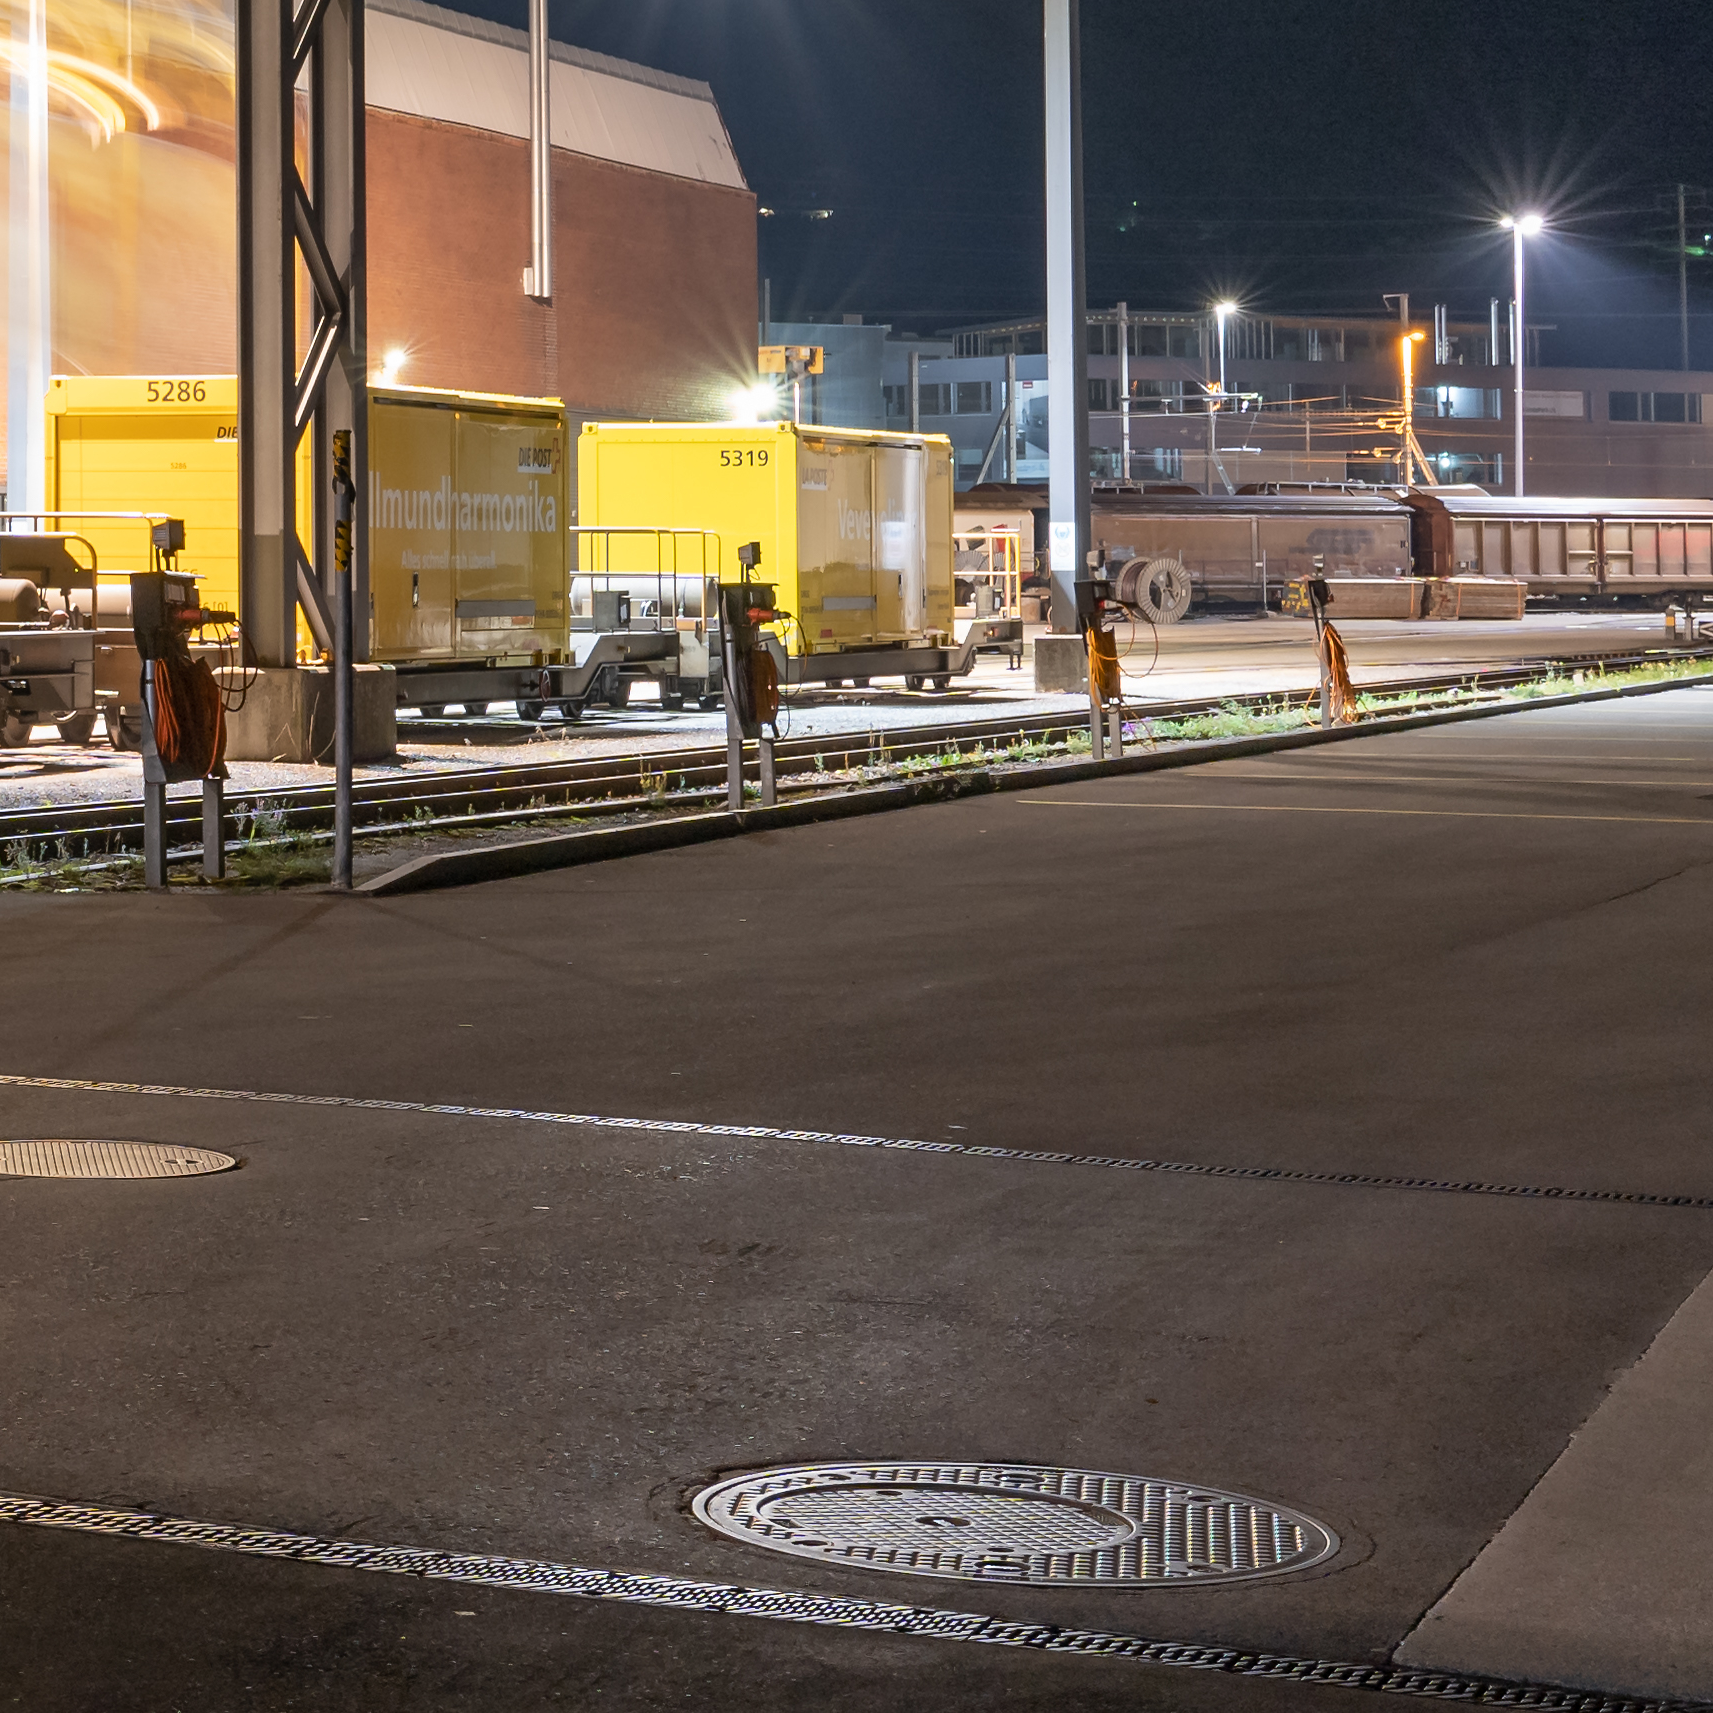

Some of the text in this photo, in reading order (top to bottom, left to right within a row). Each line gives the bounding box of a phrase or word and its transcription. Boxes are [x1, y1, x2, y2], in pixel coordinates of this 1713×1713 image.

[147, 380, 207, 403] 5286
[518, 447, 552, 468] DIE POST
[720, 450, 769, 467] 5319
